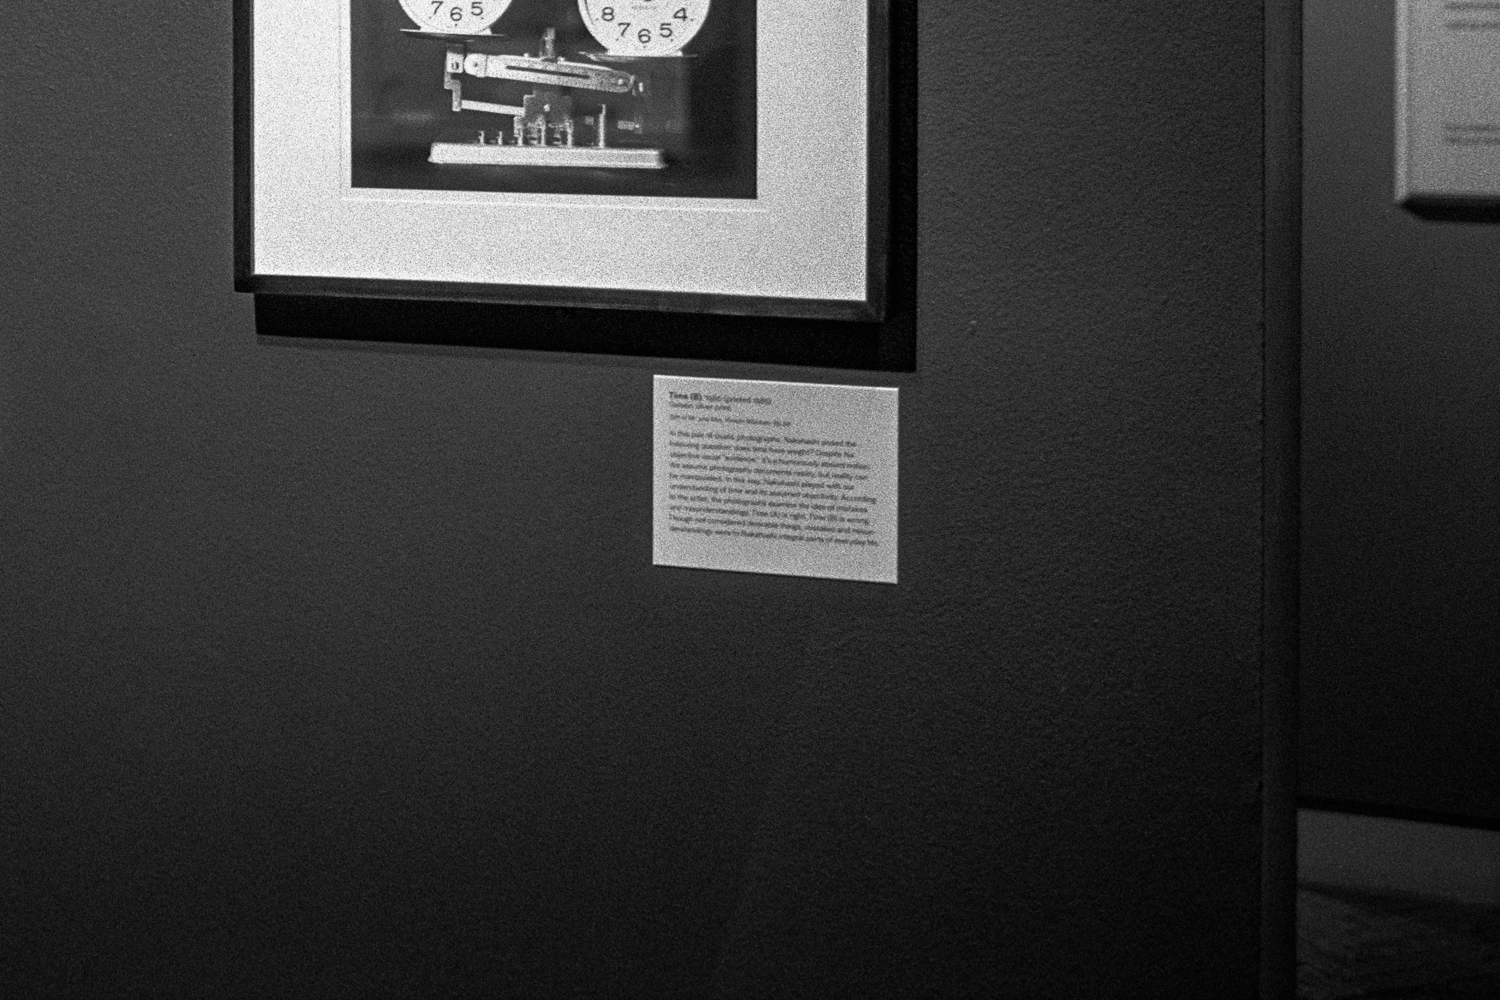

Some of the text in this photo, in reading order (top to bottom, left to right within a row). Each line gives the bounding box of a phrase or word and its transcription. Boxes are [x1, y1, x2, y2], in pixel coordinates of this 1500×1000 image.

[431, 1, 444, 15] 7
[450, 7, 462, 22] 6
[471, 1, 483, 16] 5
[602, 7, 614, 21] 8
[673, 8, 687, 22] 4
[618, 23, 631, 36] 7
[638, 29, 651, 43] 6
[660, 23, 673, 37] 5
